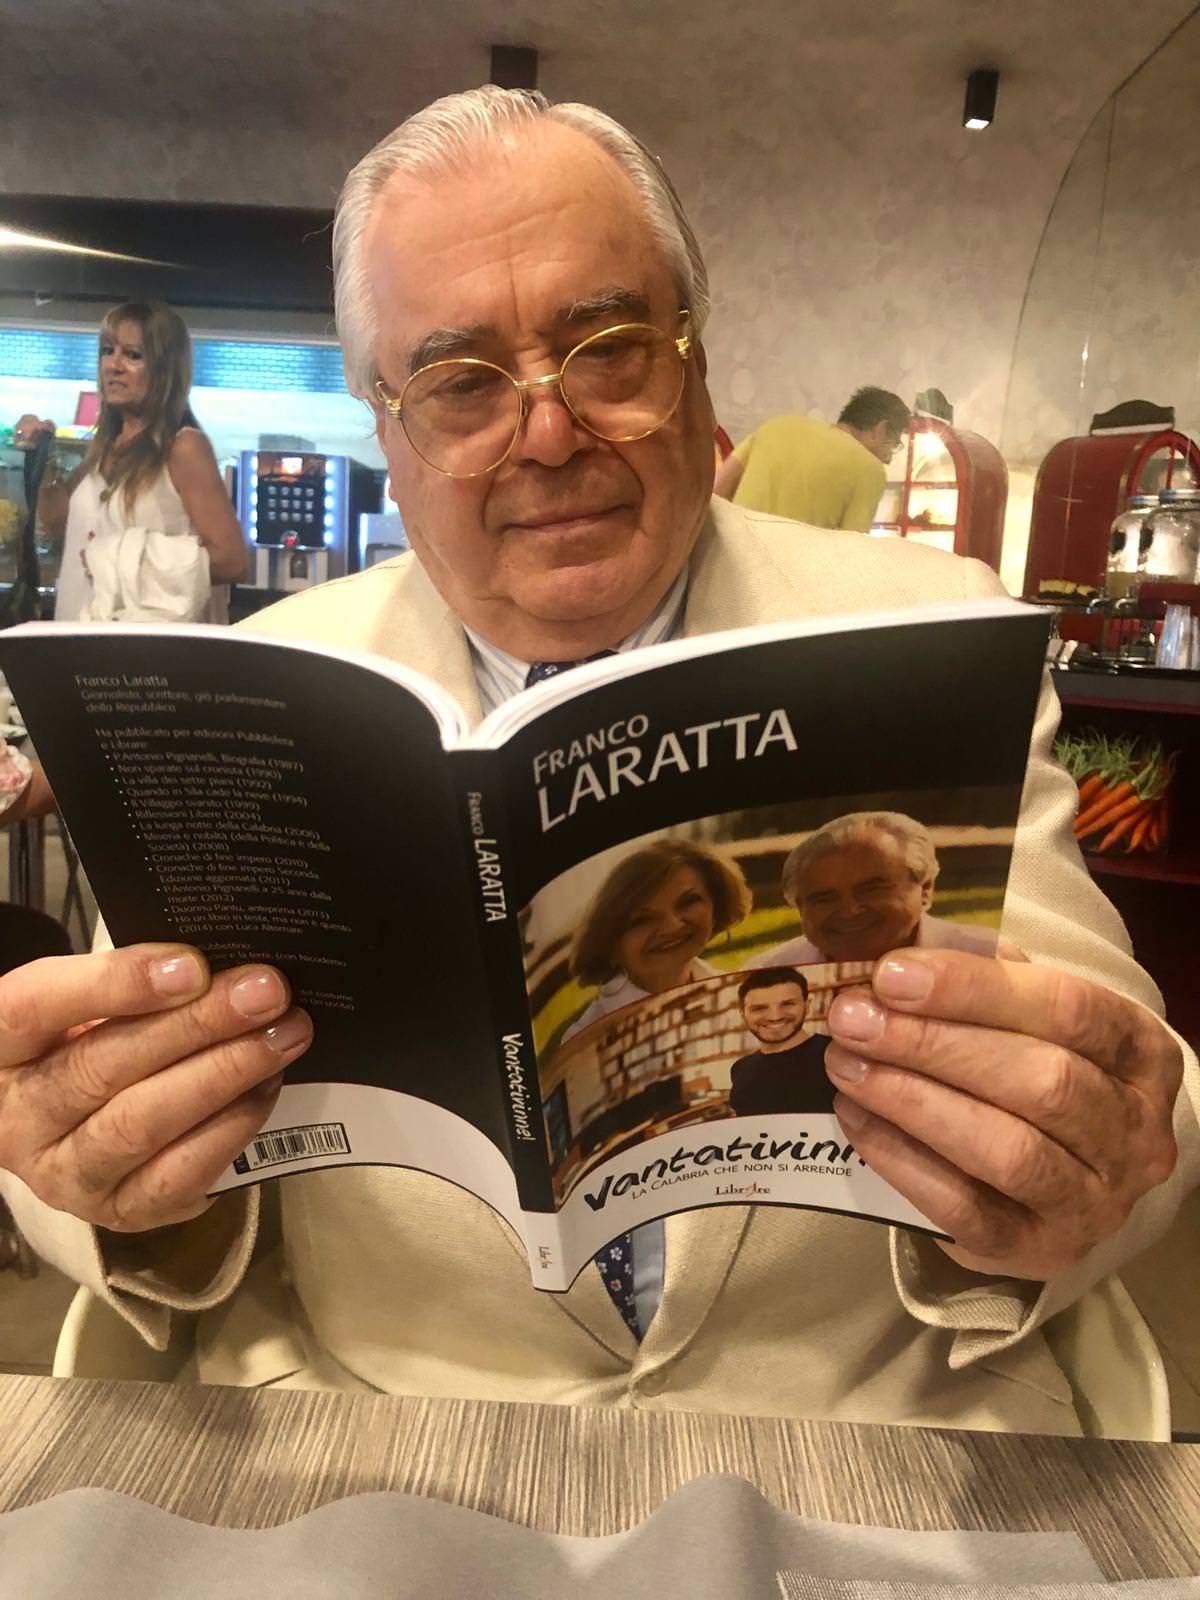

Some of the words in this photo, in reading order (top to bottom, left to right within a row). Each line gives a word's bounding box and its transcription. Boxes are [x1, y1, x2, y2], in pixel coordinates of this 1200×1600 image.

[74, 674, 120, 688] Franco
[122, 674, 169, 688] Laratta
[532, 713, 649, 785] FRANCO
[537, 708, 799, 833] LARATTA
[467, 791, 485, 836] FRANCO
[474, 838, 508, 923] LARATTA
[502, 1032, 537, 1141] Vantativinne!
[631, 1187, 647, 1200] LA
[650, 1169, 709, 1191] CALABRIA
[713, 1164, 739, 1176] CHE
[743, 1162, 773, 1173] NON
[778, 1163, 789, 1172] SI
[793, 1163, 853, 1177] ARRENDE
